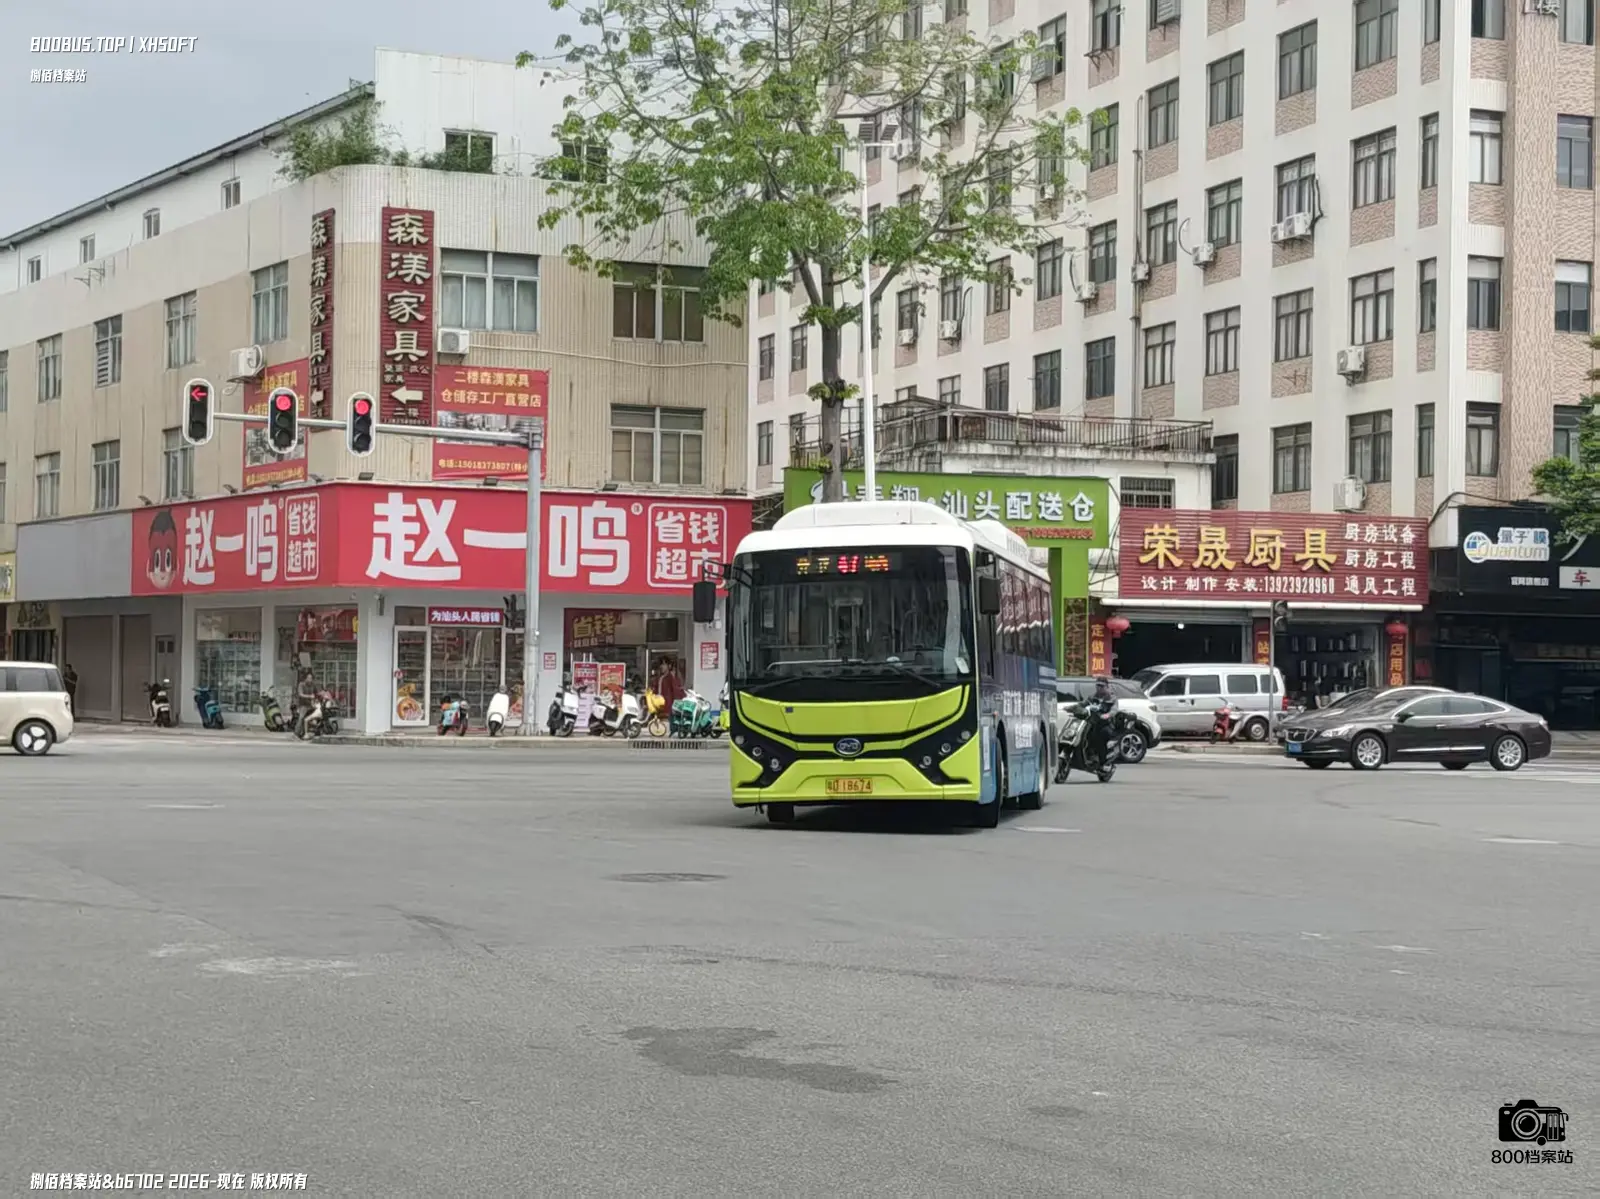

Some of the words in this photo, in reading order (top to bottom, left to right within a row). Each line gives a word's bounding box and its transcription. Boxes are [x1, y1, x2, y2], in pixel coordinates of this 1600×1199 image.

[287, 501, 317, 537] 省钱
[654, 509, 720, 546] 省钱
[1344, 522, 1417, 544] 厨房设备
[183, 498, 279, 586] 赵一鸣
[287, 538, 317, 574] 超市
[365, 492, 630, 586] 赵一鸣
[1138, 523, 1338, 572] 荣晟厨具
[654, 547, 721, 582] 超市
[1344, 548, 1417, 571] 厨房工程
[1140, 575, 1177, 592] 设计
[1184, 576, 1219, 592] 制作
[1224, 576, 1335, 595] 安装:13923928960
[1344, 575, 1417, 597] 通风工程
[1572, 569, 1591, 587] 车
